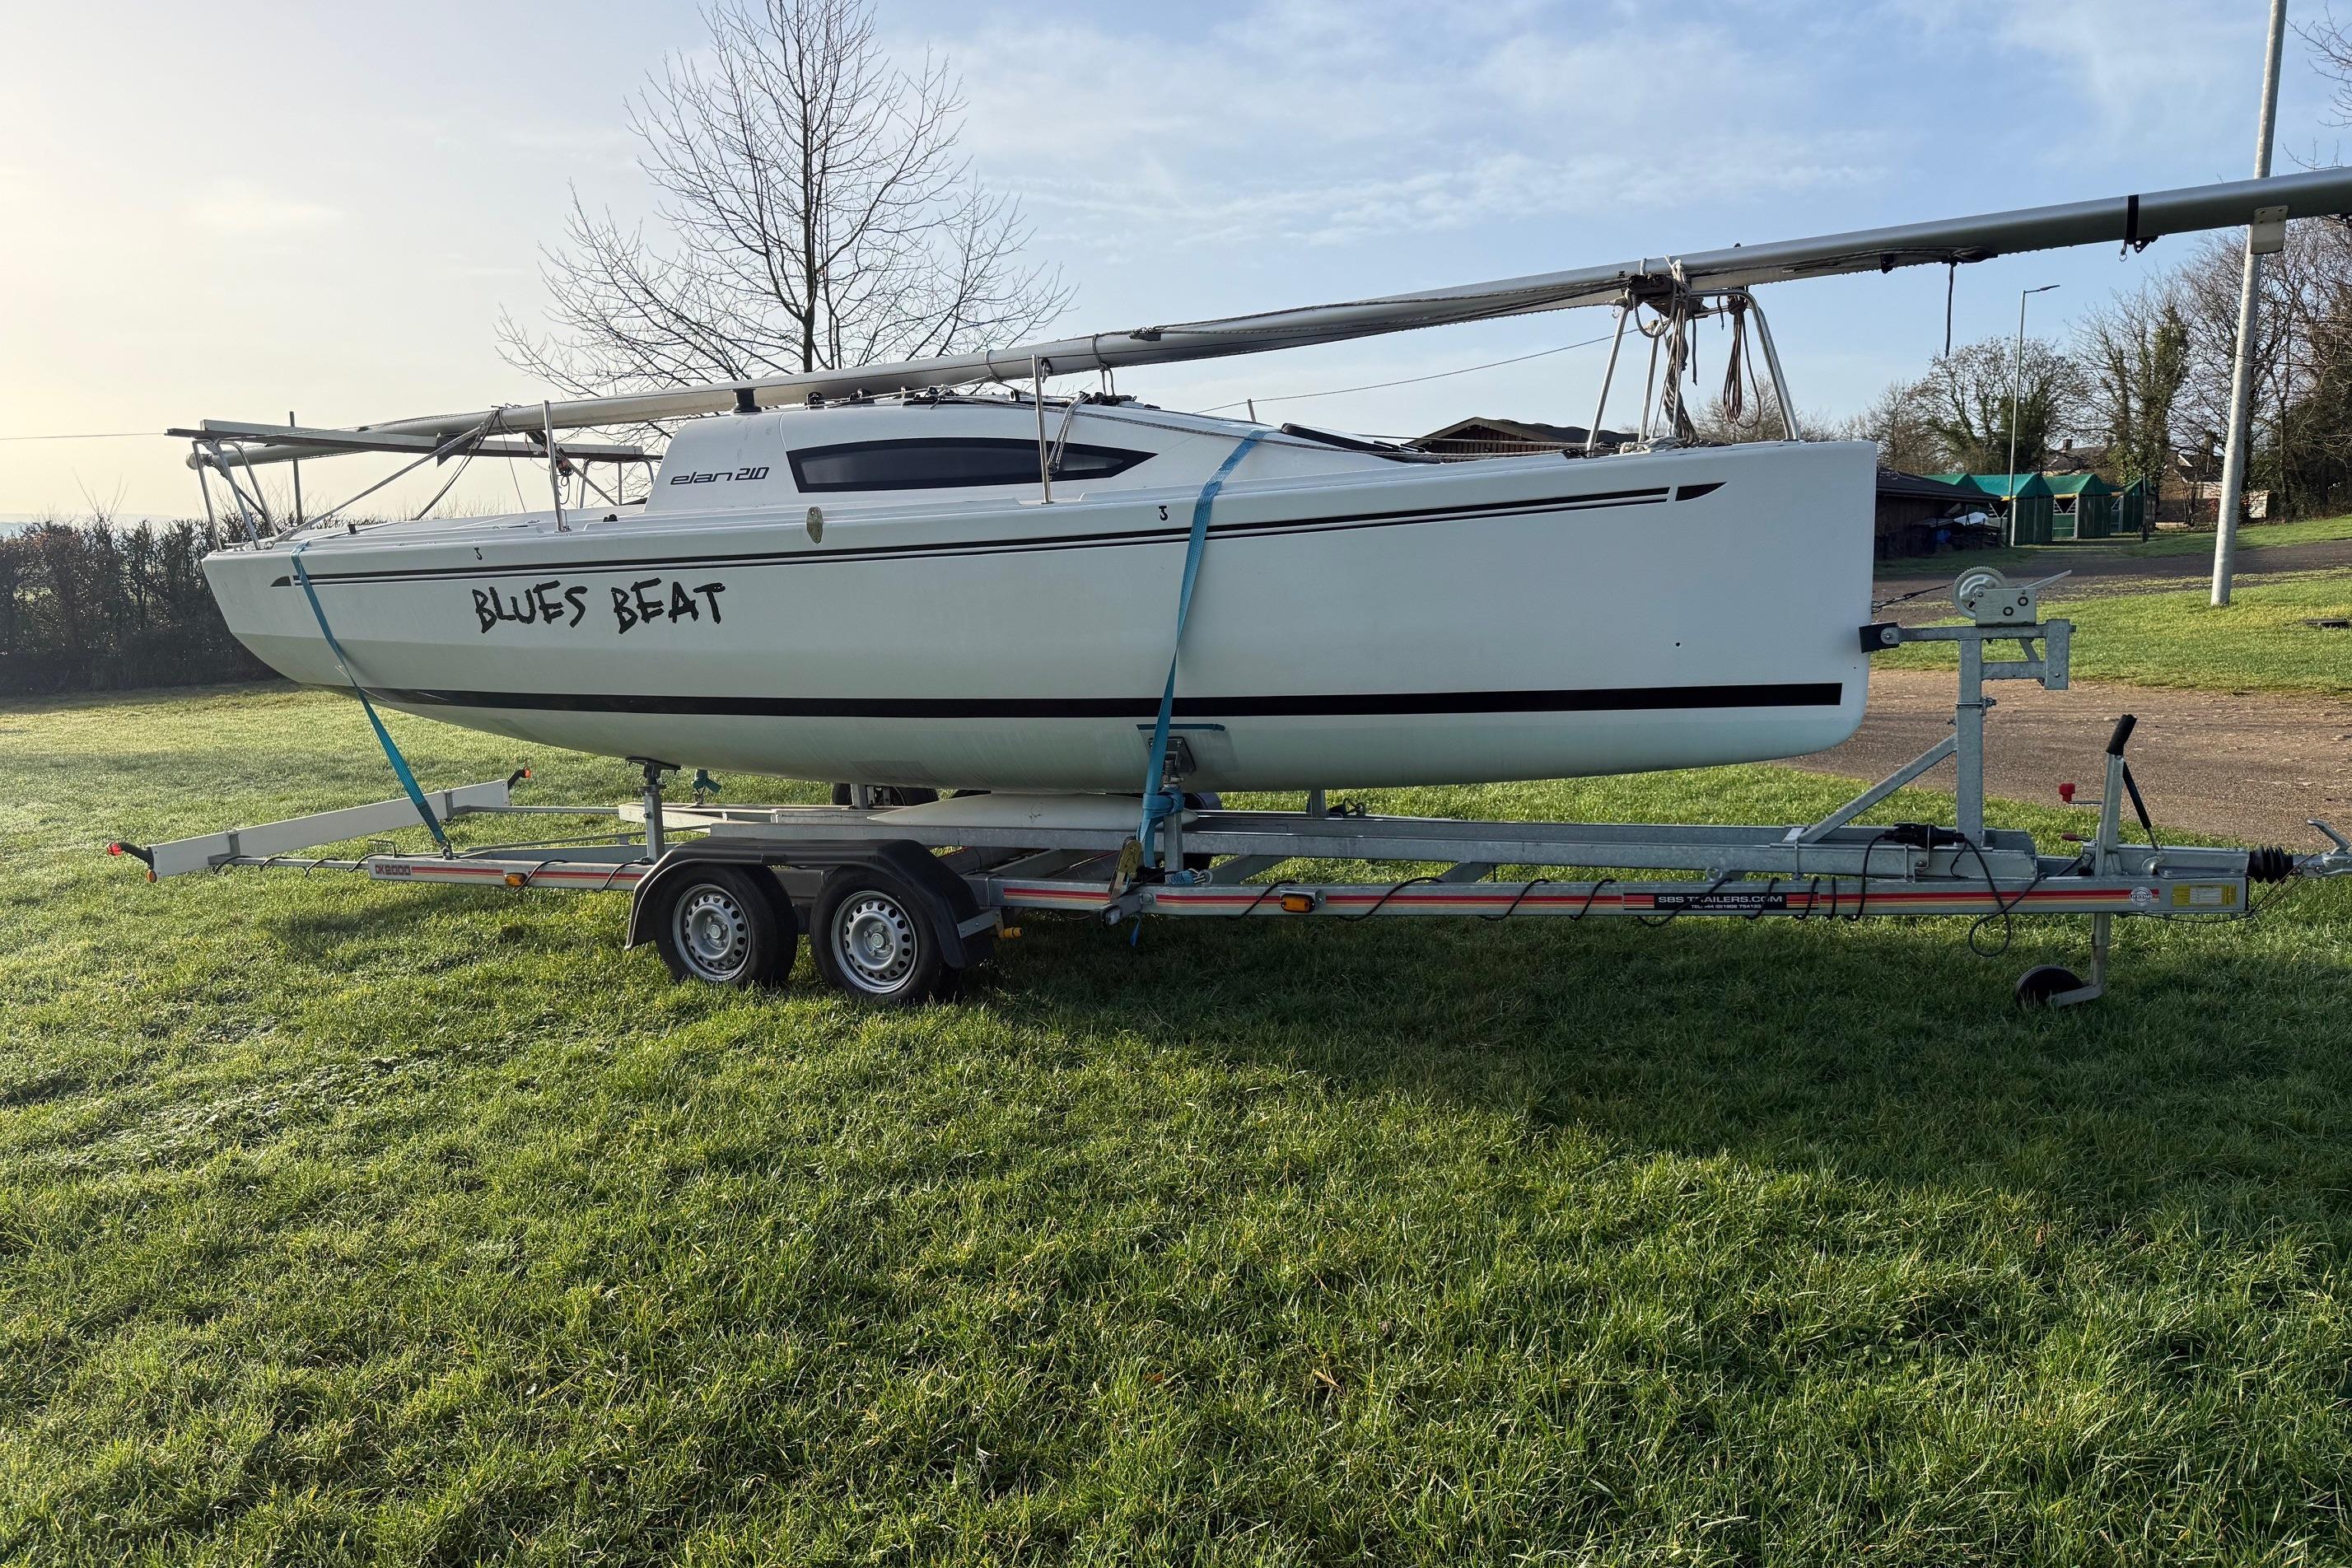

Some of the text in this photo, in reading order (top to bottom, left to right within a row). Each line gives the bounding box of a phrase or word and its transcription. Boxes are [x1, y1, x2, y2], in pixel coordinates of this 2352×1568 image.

[670, 467, 770, 485] elan 210
[472, 577, 726, 634] BLUES BEAT
